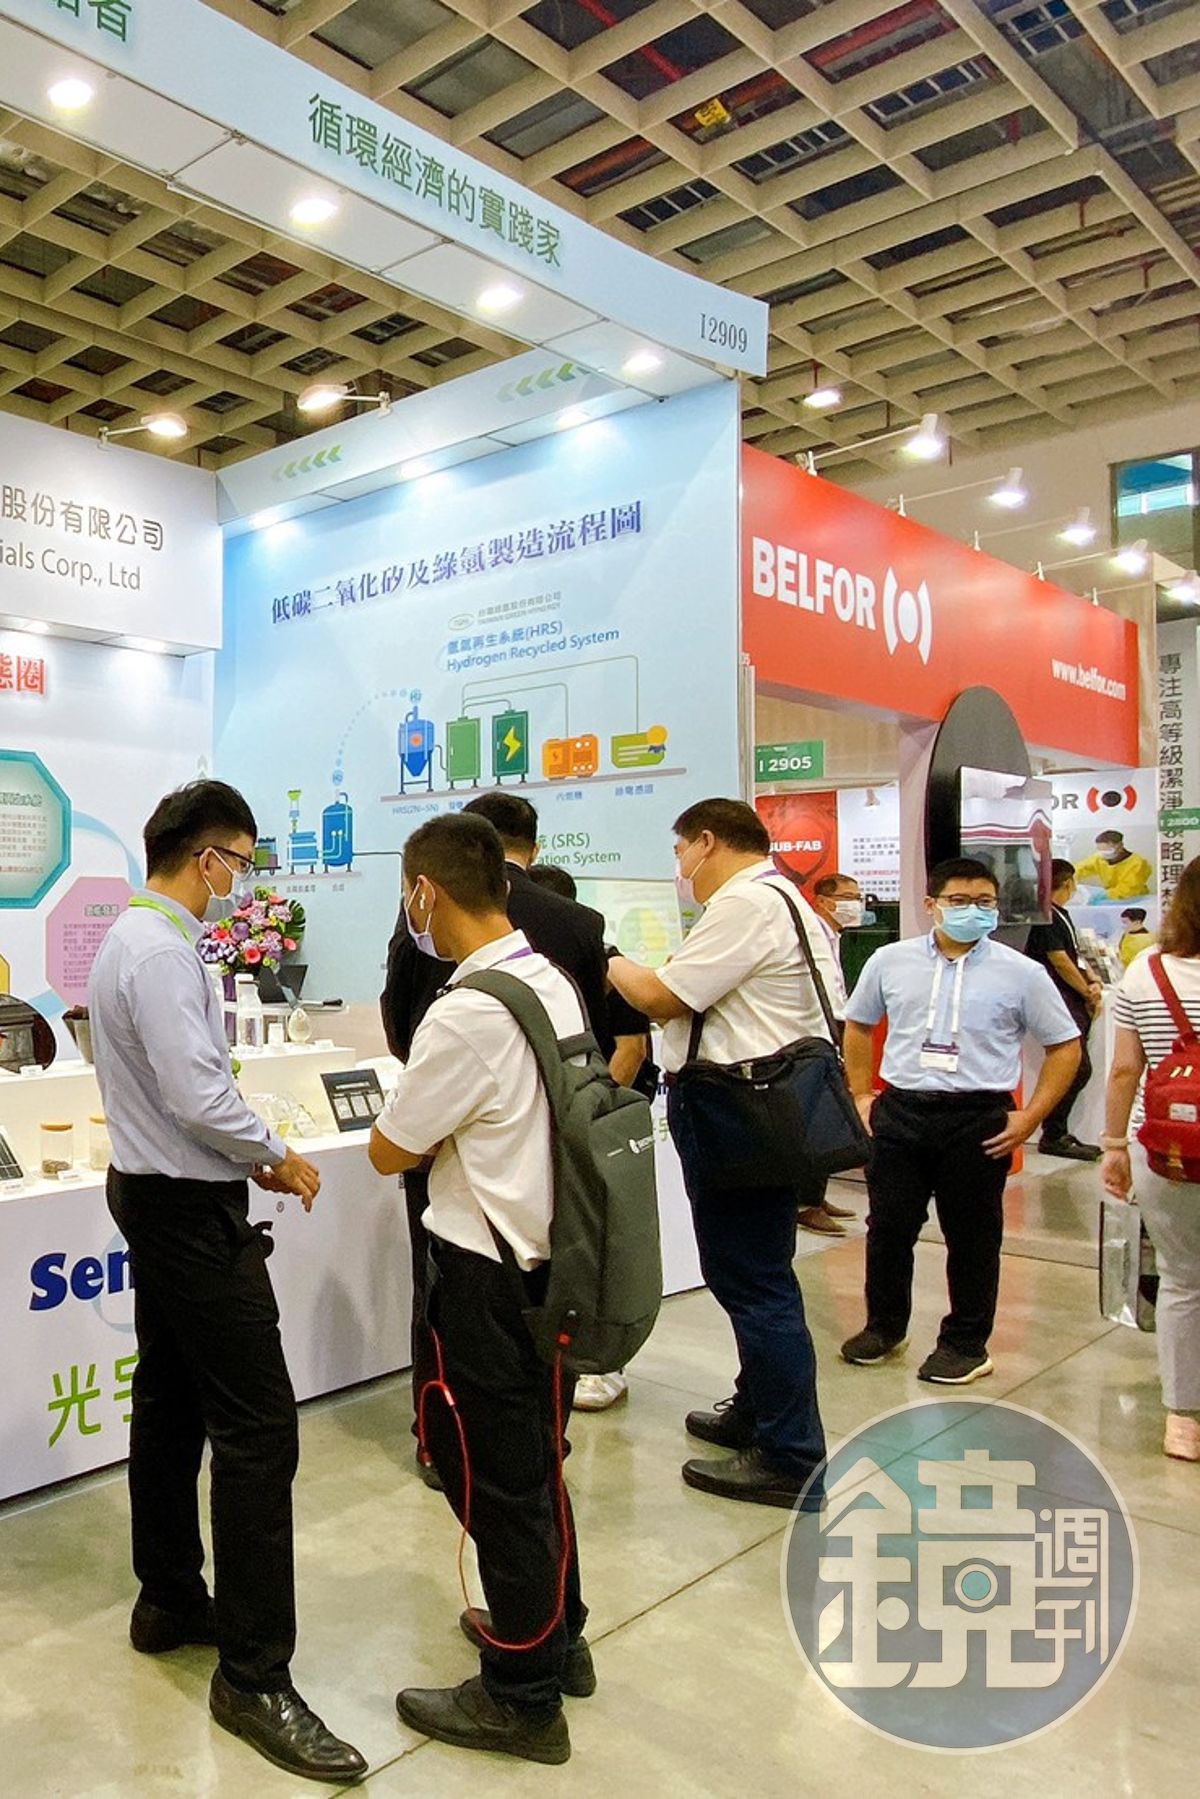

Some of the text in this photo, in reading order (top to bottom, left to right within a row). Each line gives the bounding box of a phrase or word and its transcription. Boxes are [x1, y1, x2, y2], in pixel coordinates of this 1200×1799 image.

[308, 92, 562, 268] 循環經濟的實踐家
[700, 312, 748, 353] I2909
[1, 485, 165, 551] 股份有限公司
[272, 500, 642, 624] 低碳二氧化矽及綠氫製造流程圖
[752, 535, 877, 631] BELFOR
[447, 628, 620, 673] Hydrogen Recycled System
[1050, 658, 1127, 701] www.belfor.com
[768, 756, 812, 772] 2905
[574, 850, 621, 867] System
